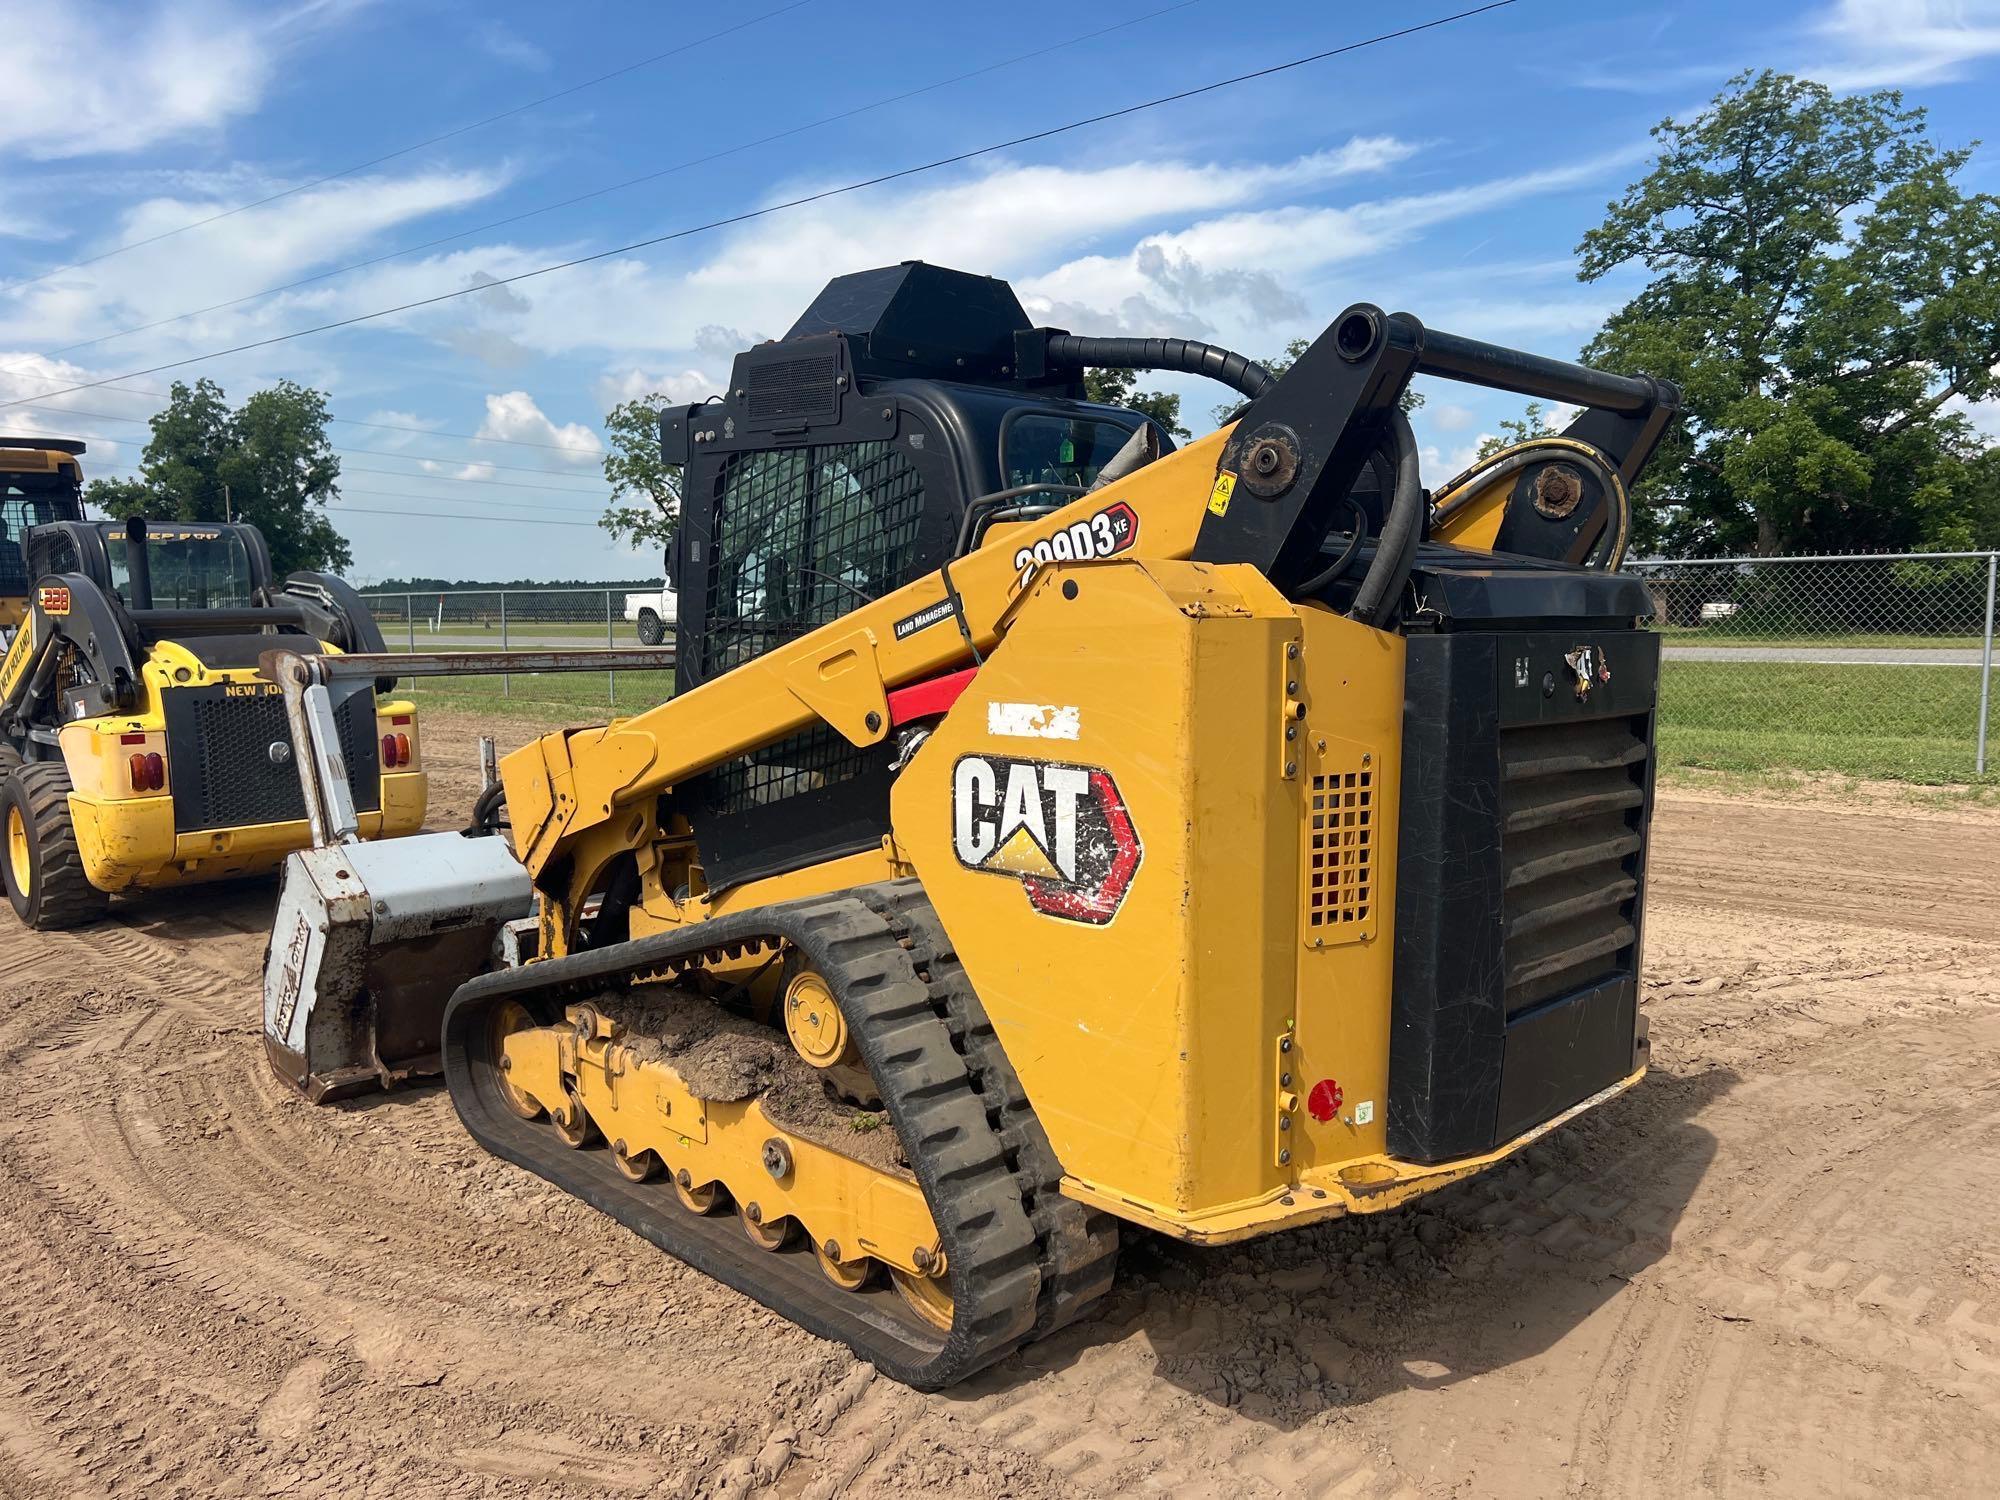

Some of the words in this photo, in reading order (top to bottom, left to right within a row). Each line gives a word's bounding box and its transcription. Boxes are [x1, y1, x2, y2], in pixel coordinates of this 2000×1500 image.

[1113, 518, 1129, 536] XE
[915, 602, 954, 628] MANAGEME
[225, 685, 257, 698] NEW
[955, 757, 1089, 882] CAT
